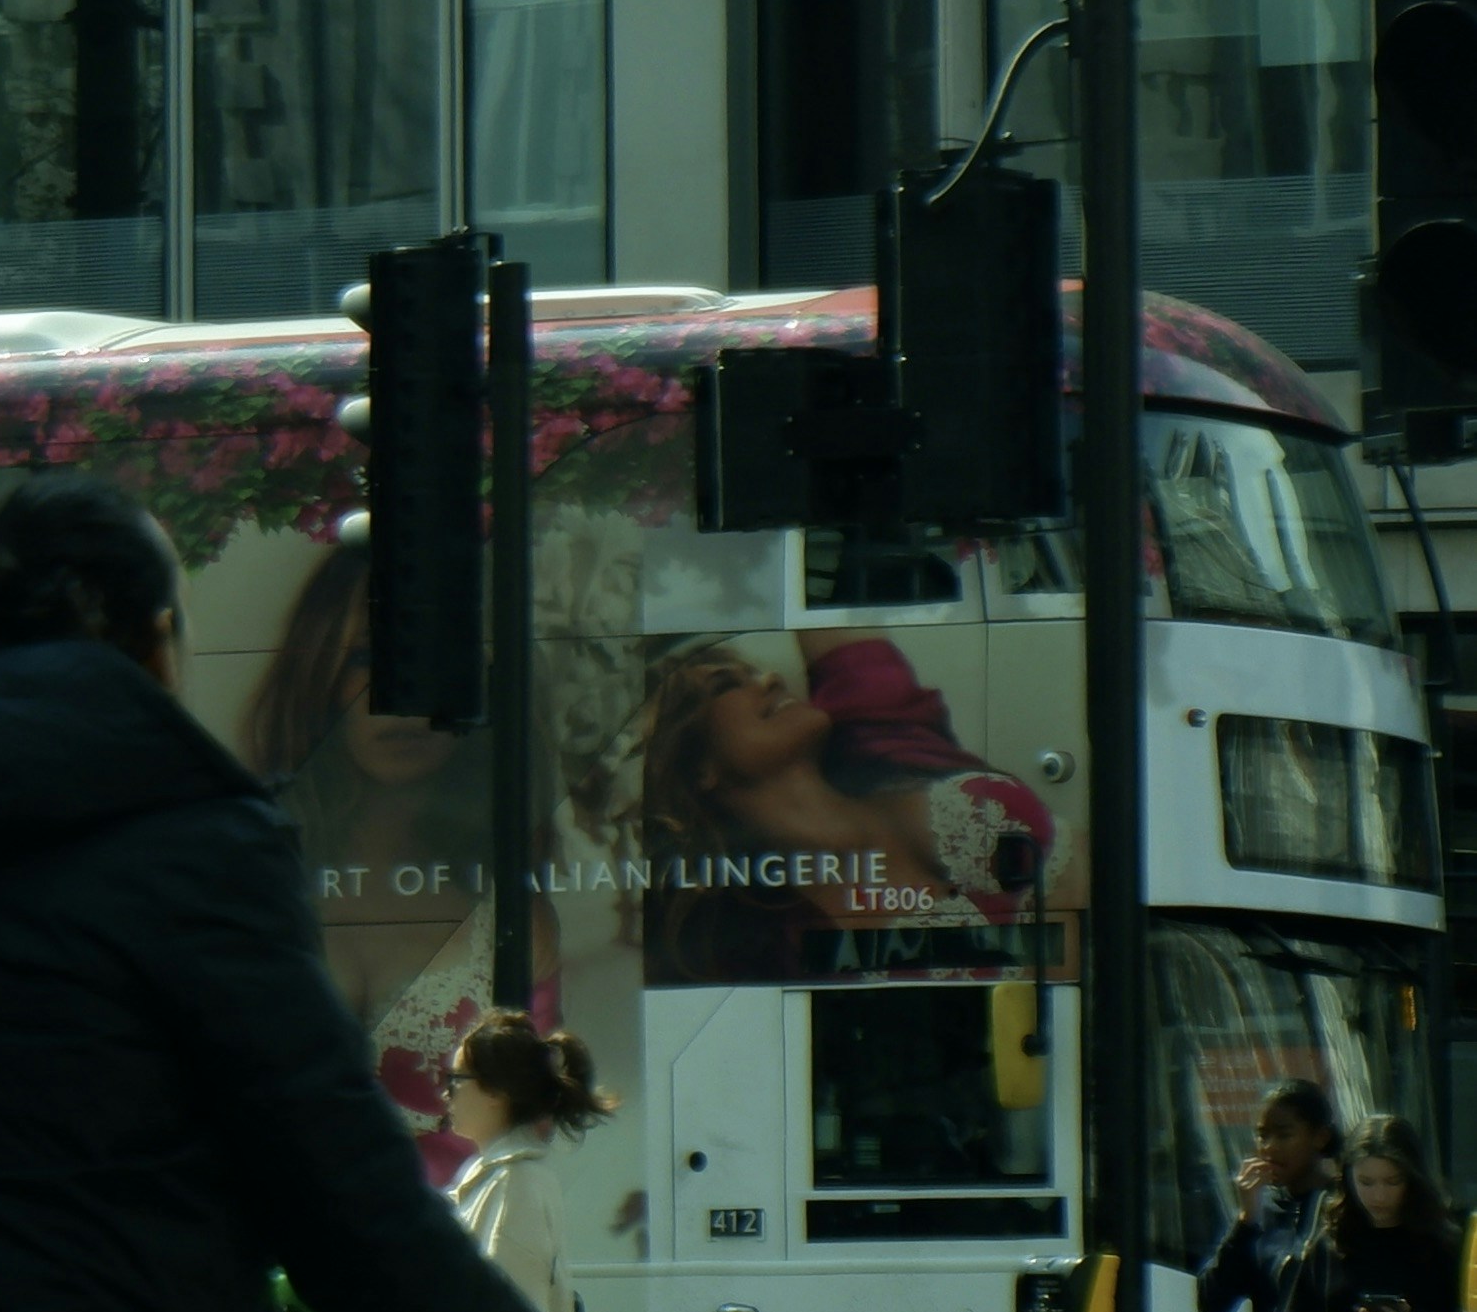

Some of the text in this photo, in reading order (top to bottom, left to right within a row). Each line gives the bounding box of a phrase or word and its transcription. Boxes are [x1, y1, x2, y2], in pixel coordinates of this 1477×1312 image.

[322, 866, 371, 899] RT
[394, 864, 451, 895] OF
[677, 852, 888, 889] LINGERIE
[850, 886, 935, 912] LT806
[713, 1209, 758, 1233] 412
